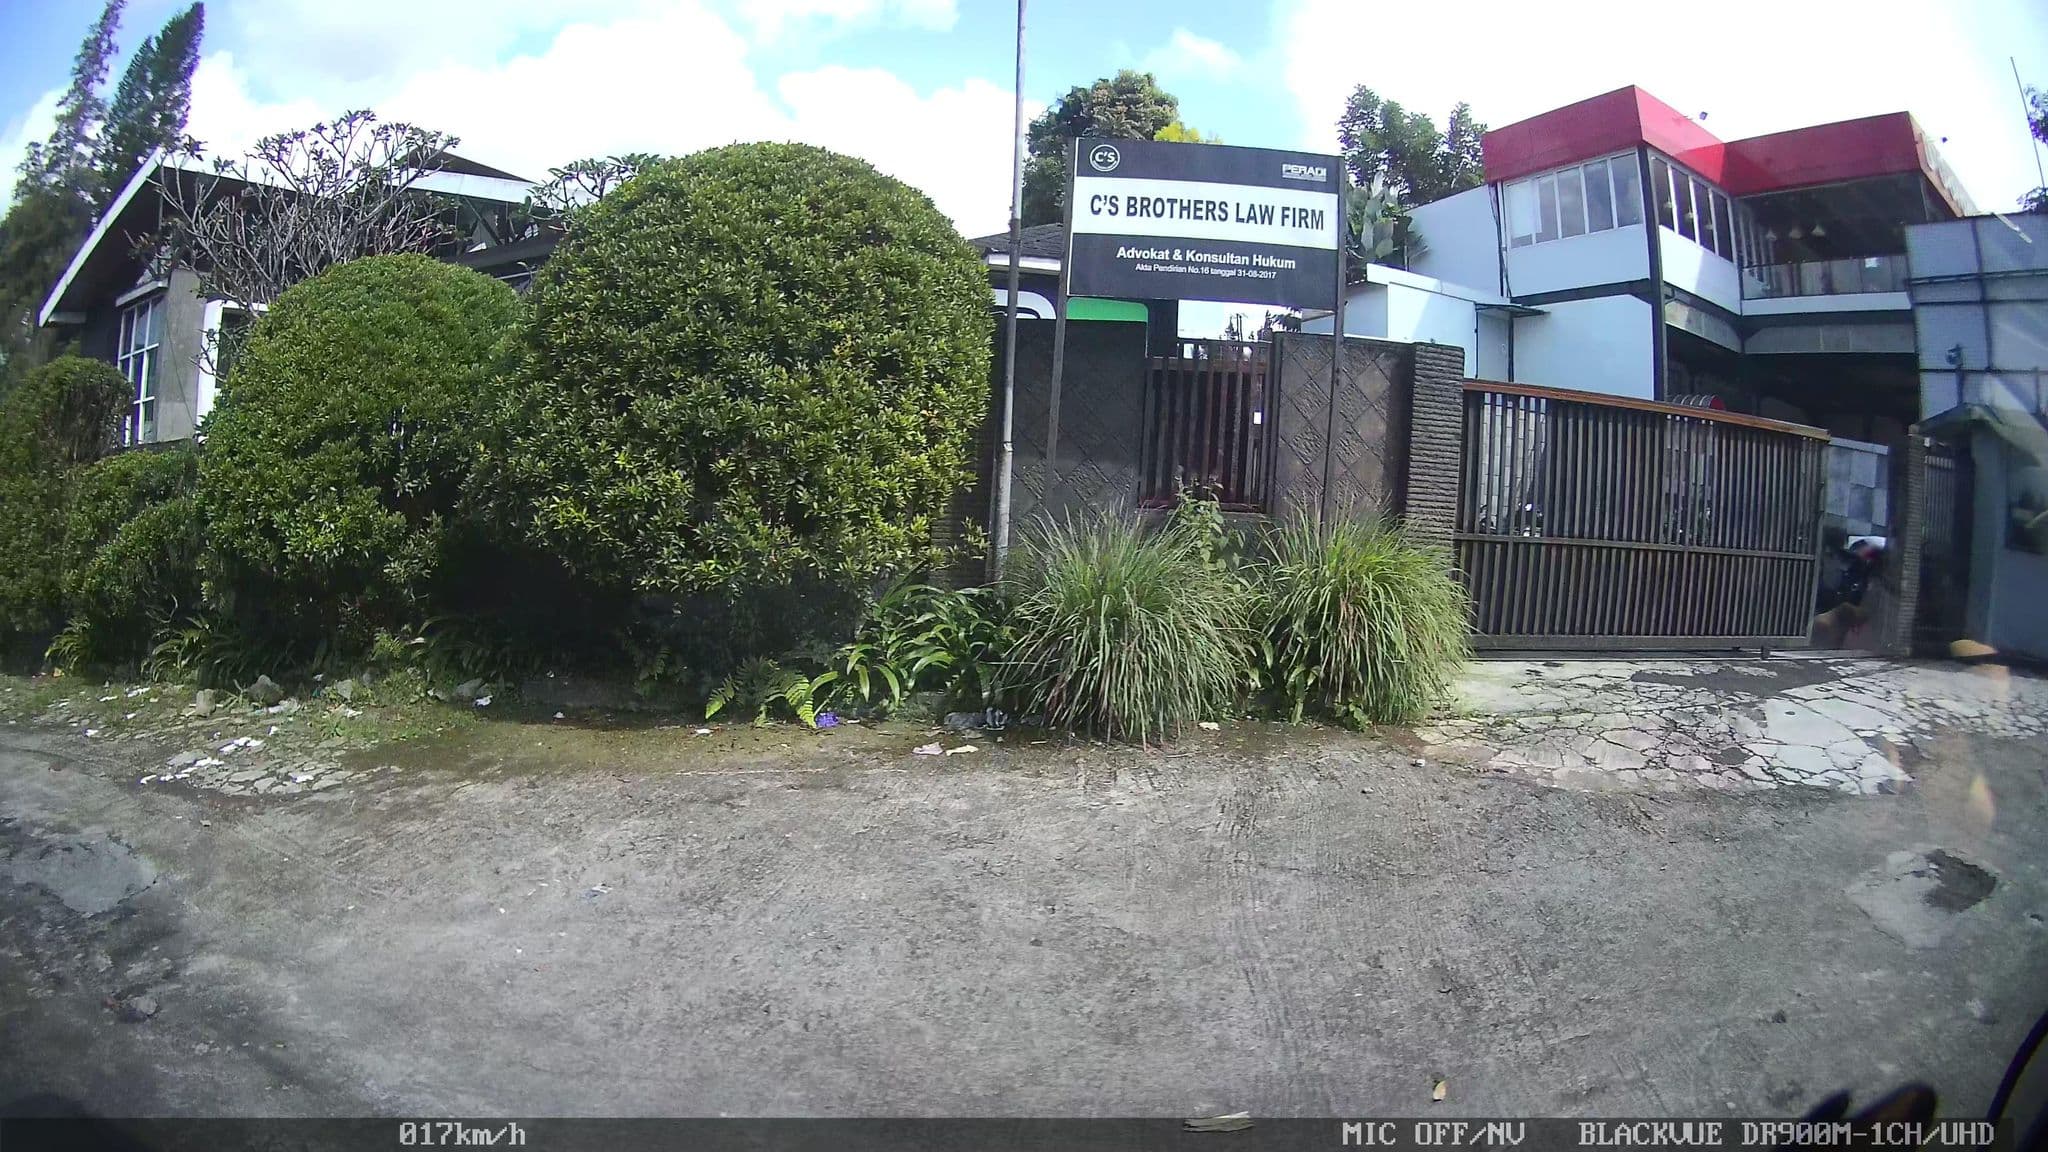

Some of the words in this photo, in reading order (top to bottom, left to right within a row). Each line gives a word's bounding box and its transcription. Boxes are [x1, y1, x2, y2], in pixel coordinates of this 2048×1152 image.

[1090, 194, 1120, 217] C'S
[1126, 196, 1229, 223] BROTHERS
[1235, 202, 1275, 226] LAW
[1281, 206, 1325, 231] FIRM
[1116, 246, 1170, 260] Advokat
[1172, 249, 1183, 261] &
[1186, 250, 1250, 266] Konsultan
[1252, 254, 1296, 270] Hukum
